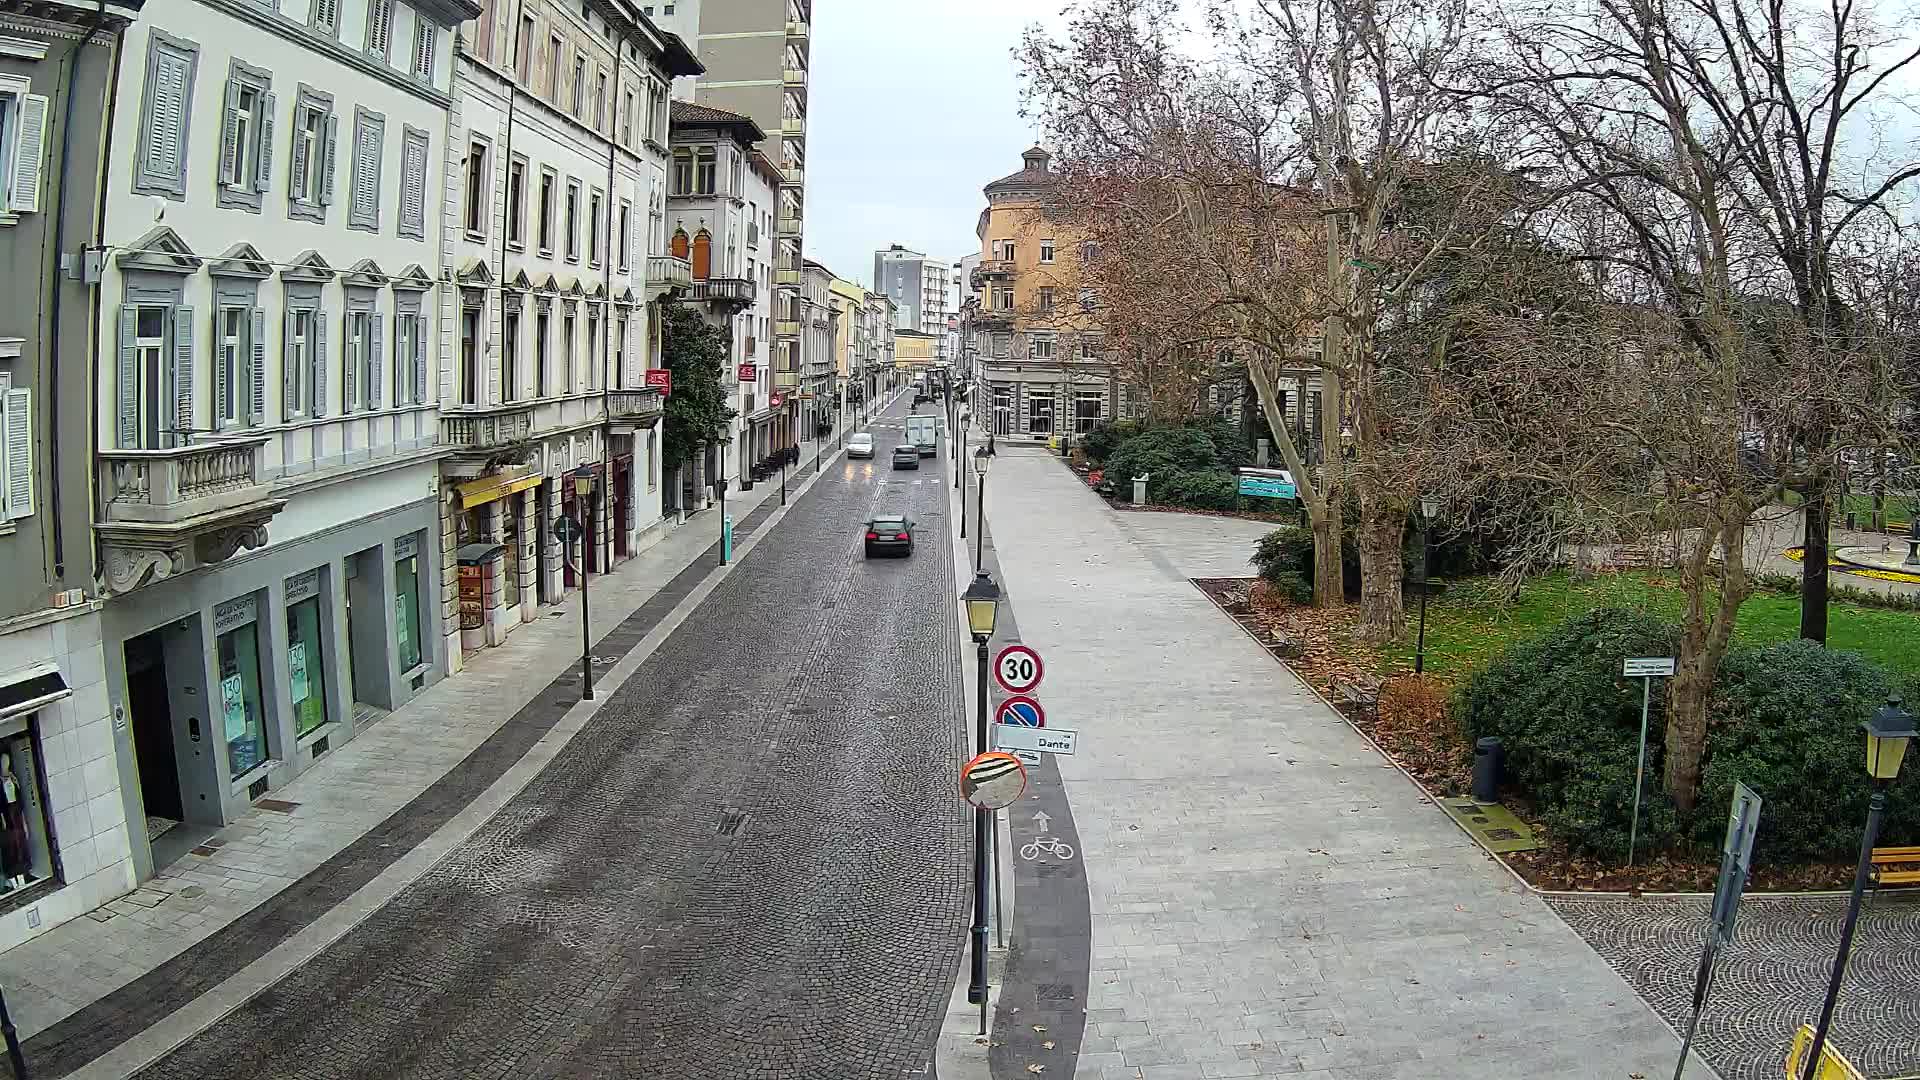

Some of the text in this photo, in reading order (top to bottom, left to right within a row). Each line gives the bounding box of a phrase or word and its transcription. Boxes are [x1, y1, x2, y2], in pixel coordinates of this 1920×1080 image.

[1006, 658, 1032, 680] 30
[223, 677, 241, 701] 130
[1038, 738, 1070, 749] Dante
